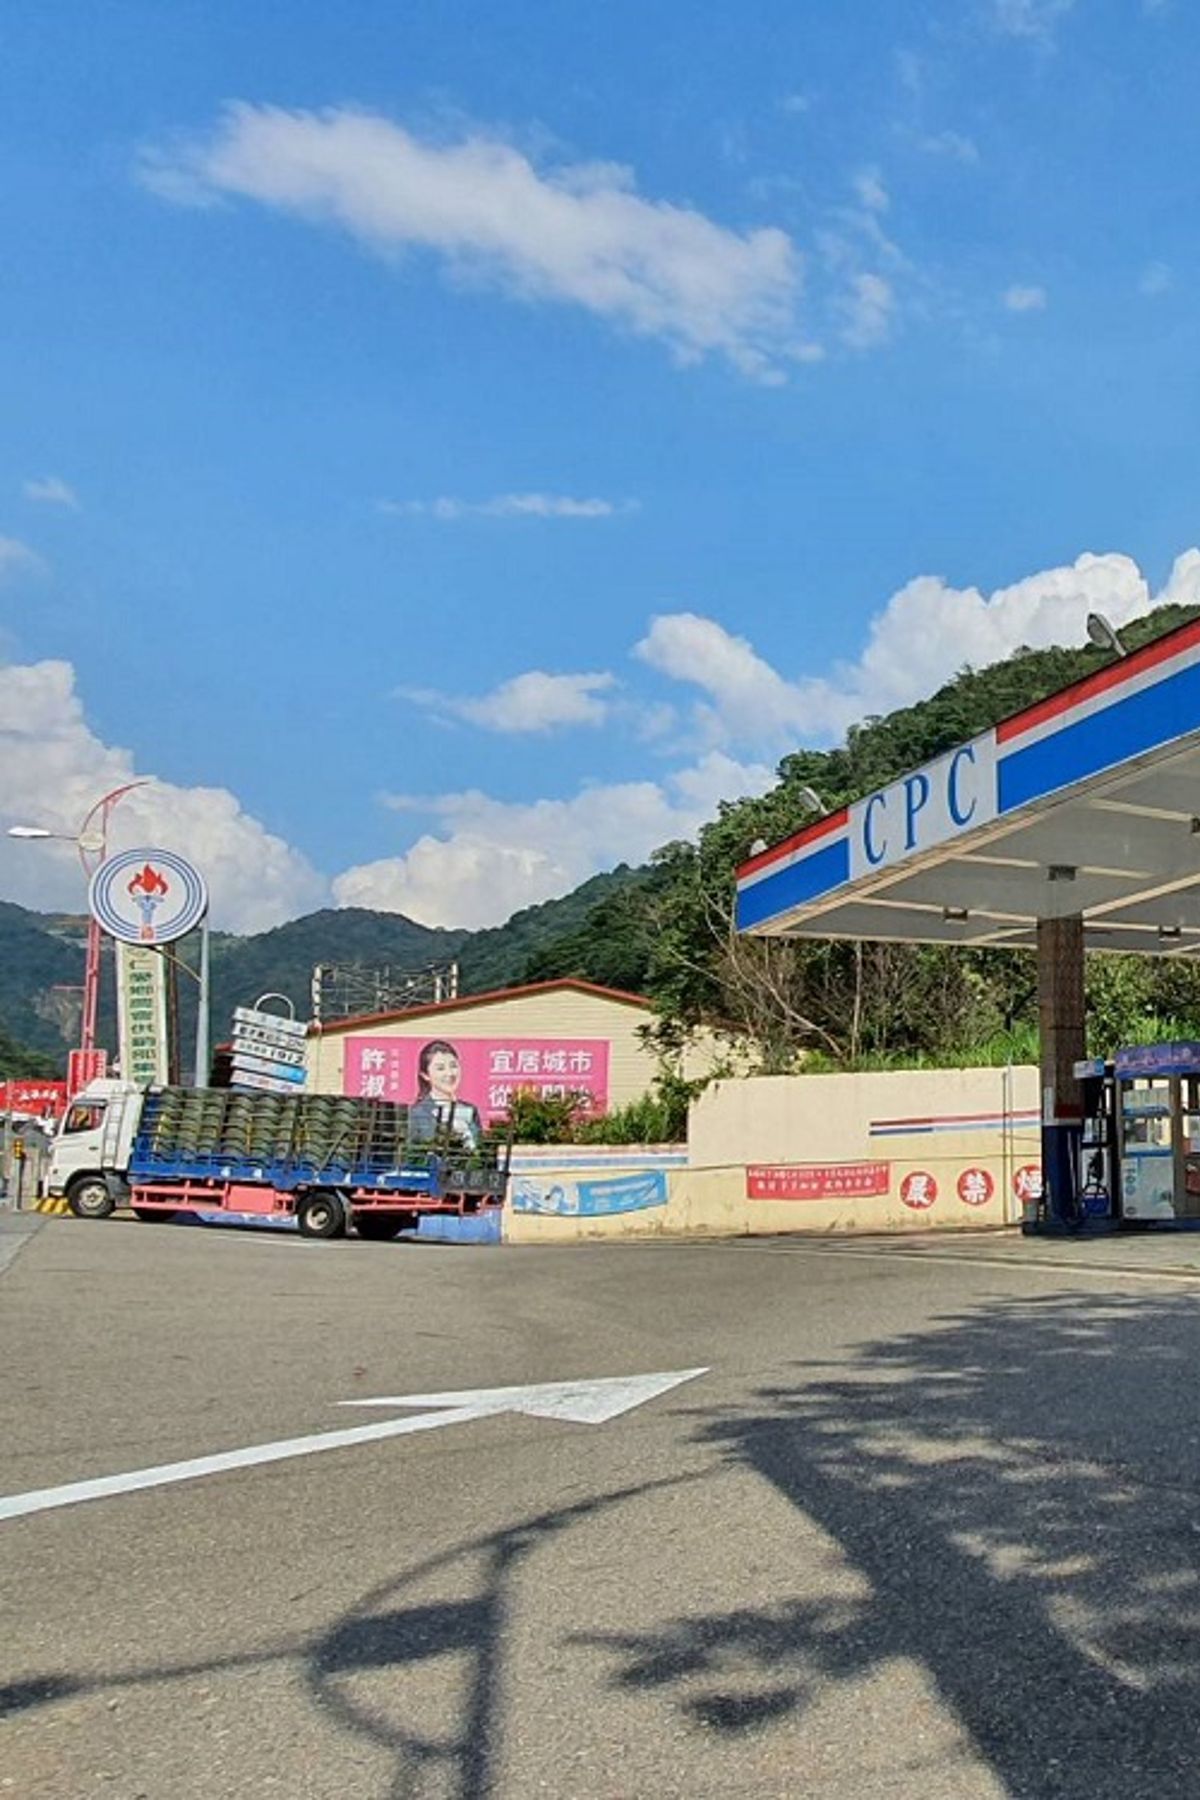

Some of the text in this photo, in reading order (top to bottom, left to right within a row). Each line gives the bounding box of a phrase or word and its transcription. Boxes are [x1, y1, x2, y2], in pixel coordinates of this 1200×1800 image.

[863, 744, 977, 865] CPC
[489, 1049, 593, 1074] 宜居城市
